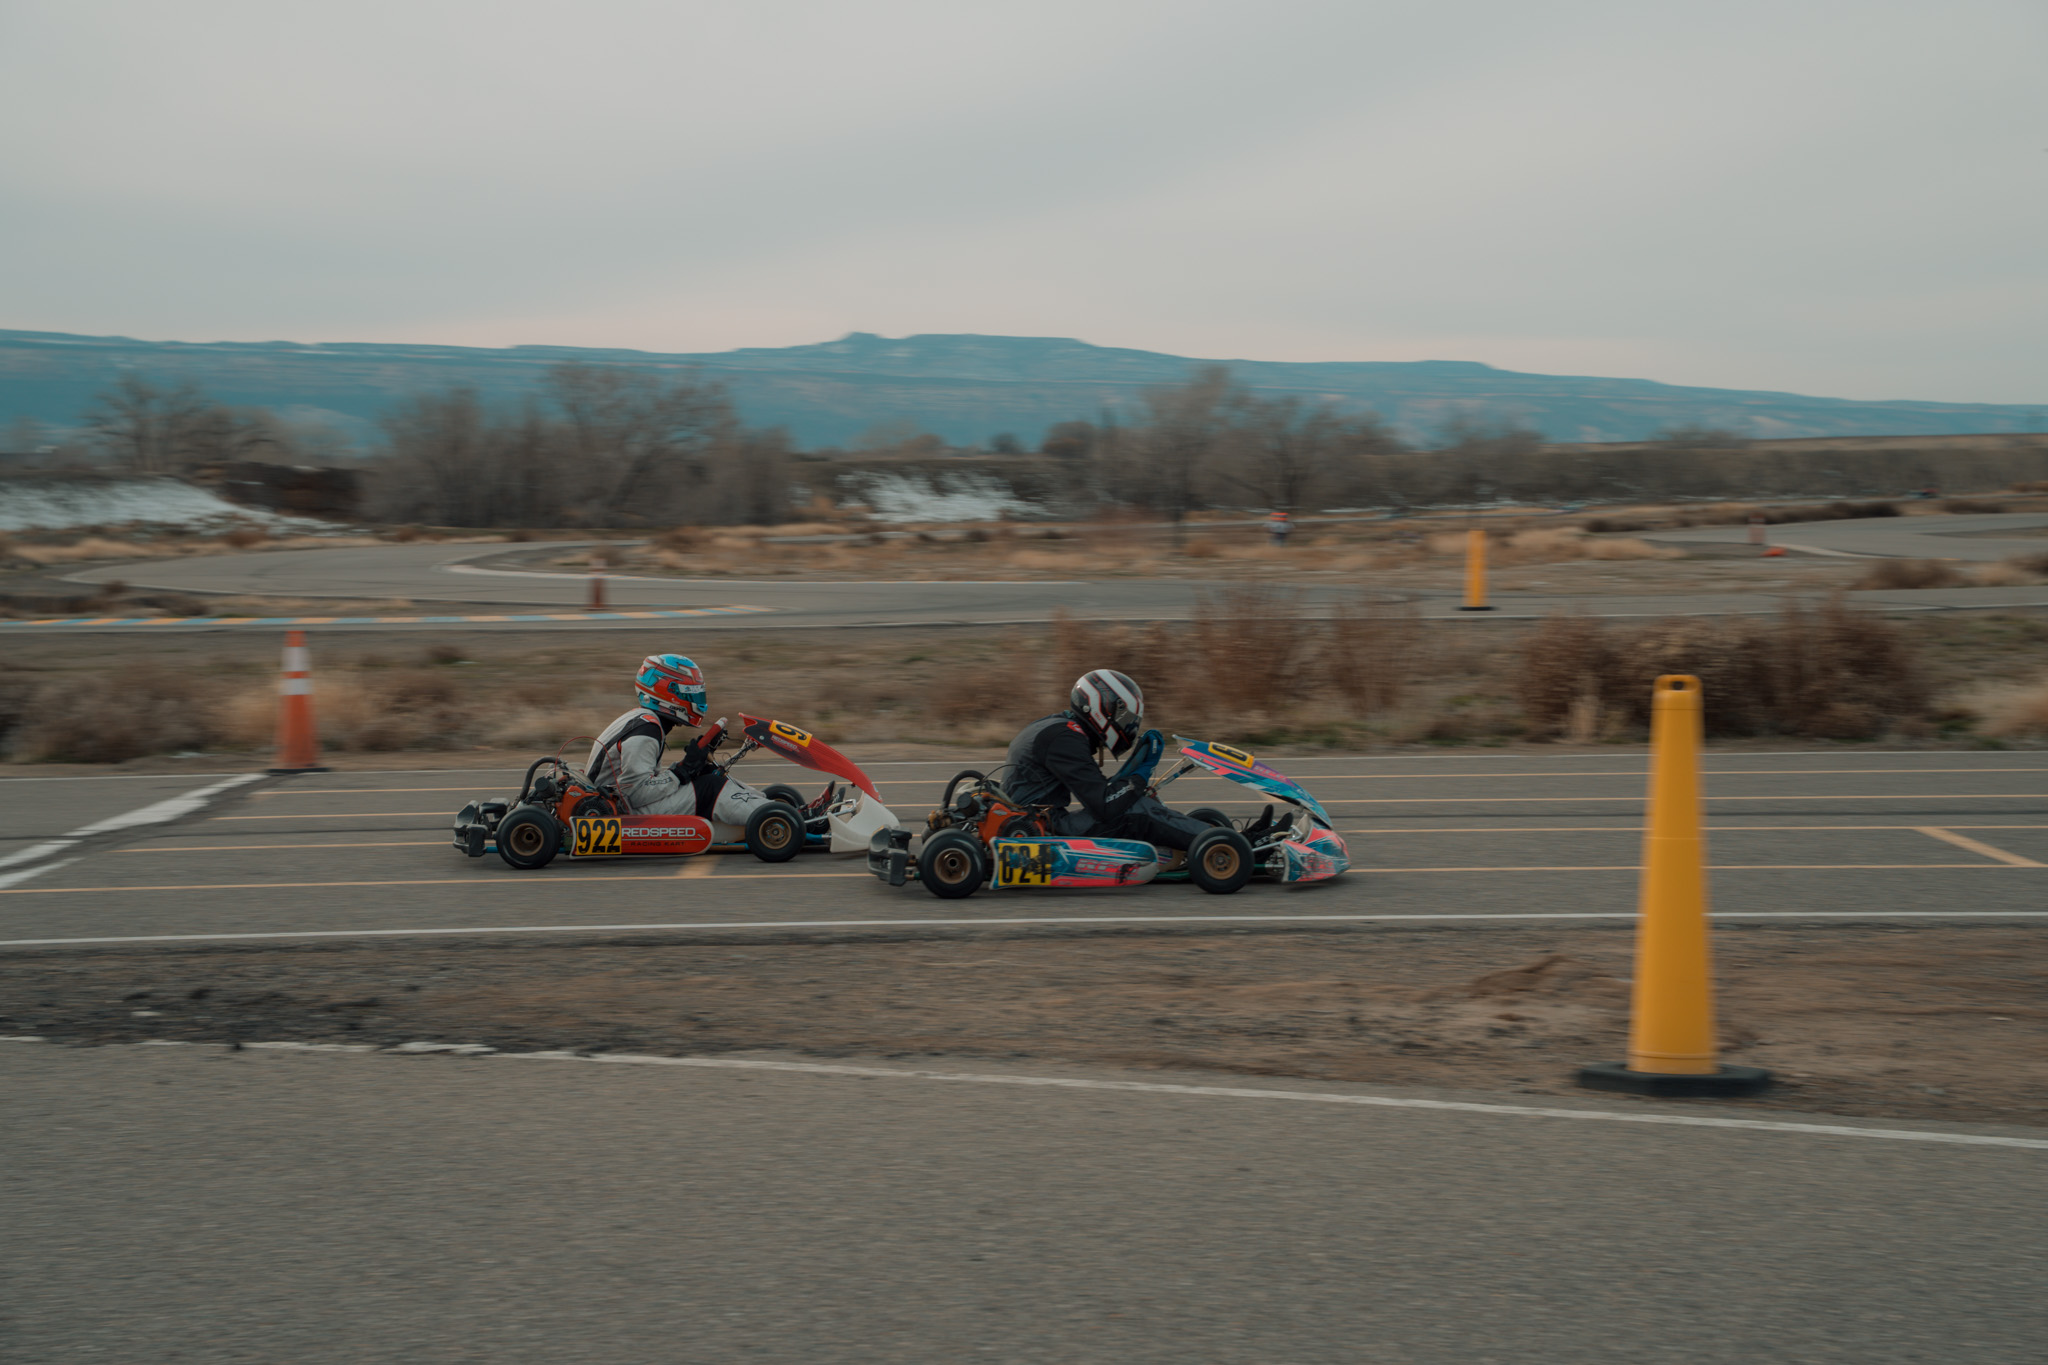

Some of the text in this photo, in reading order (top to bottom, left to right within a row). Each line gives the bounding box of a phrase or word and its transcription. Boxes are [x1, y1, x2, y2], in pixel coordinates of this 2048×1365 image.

[776, 723, 807, 740] 9
[577, 819, 620, 854] 922
[621, 827, 696, 837] REDSPEED
